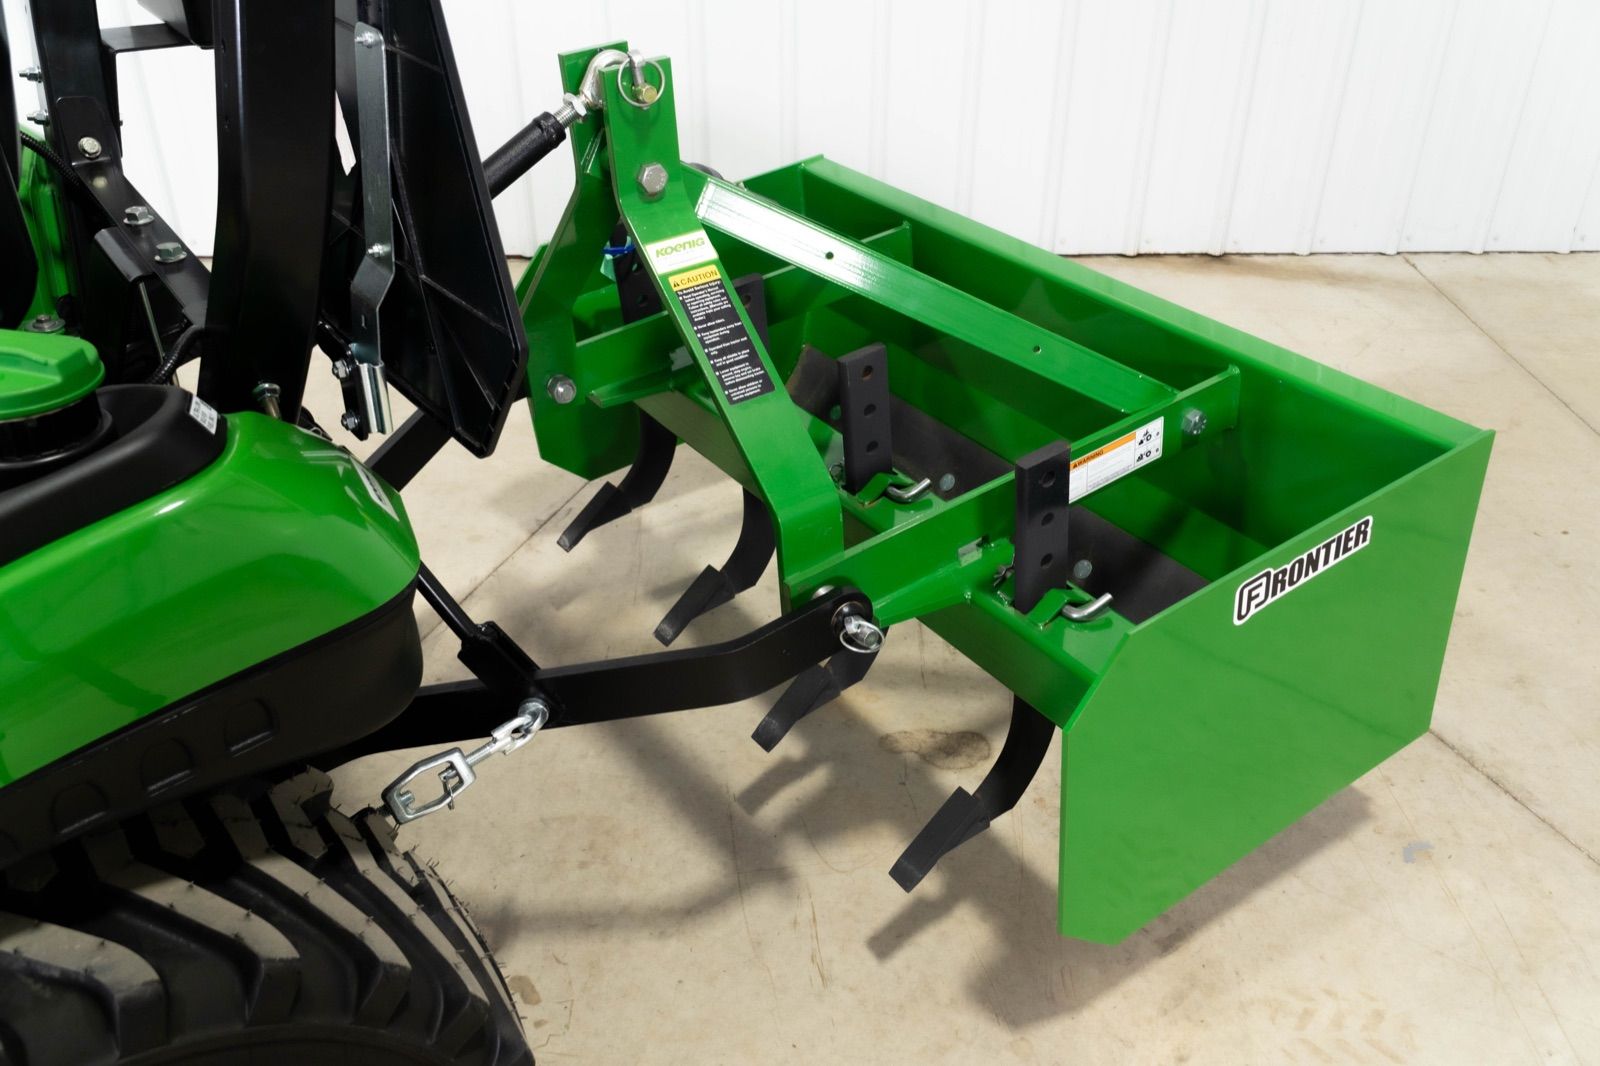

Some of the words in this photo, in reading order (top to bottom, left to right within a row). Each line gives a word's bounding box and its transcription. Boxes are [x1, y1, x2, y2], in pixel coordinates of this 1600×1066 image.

[680, 270, 718, 286] CAUTION
[1076, 449, 1104, 466] WARNING
[1236, 517, 1371, 622] FRONTIER
